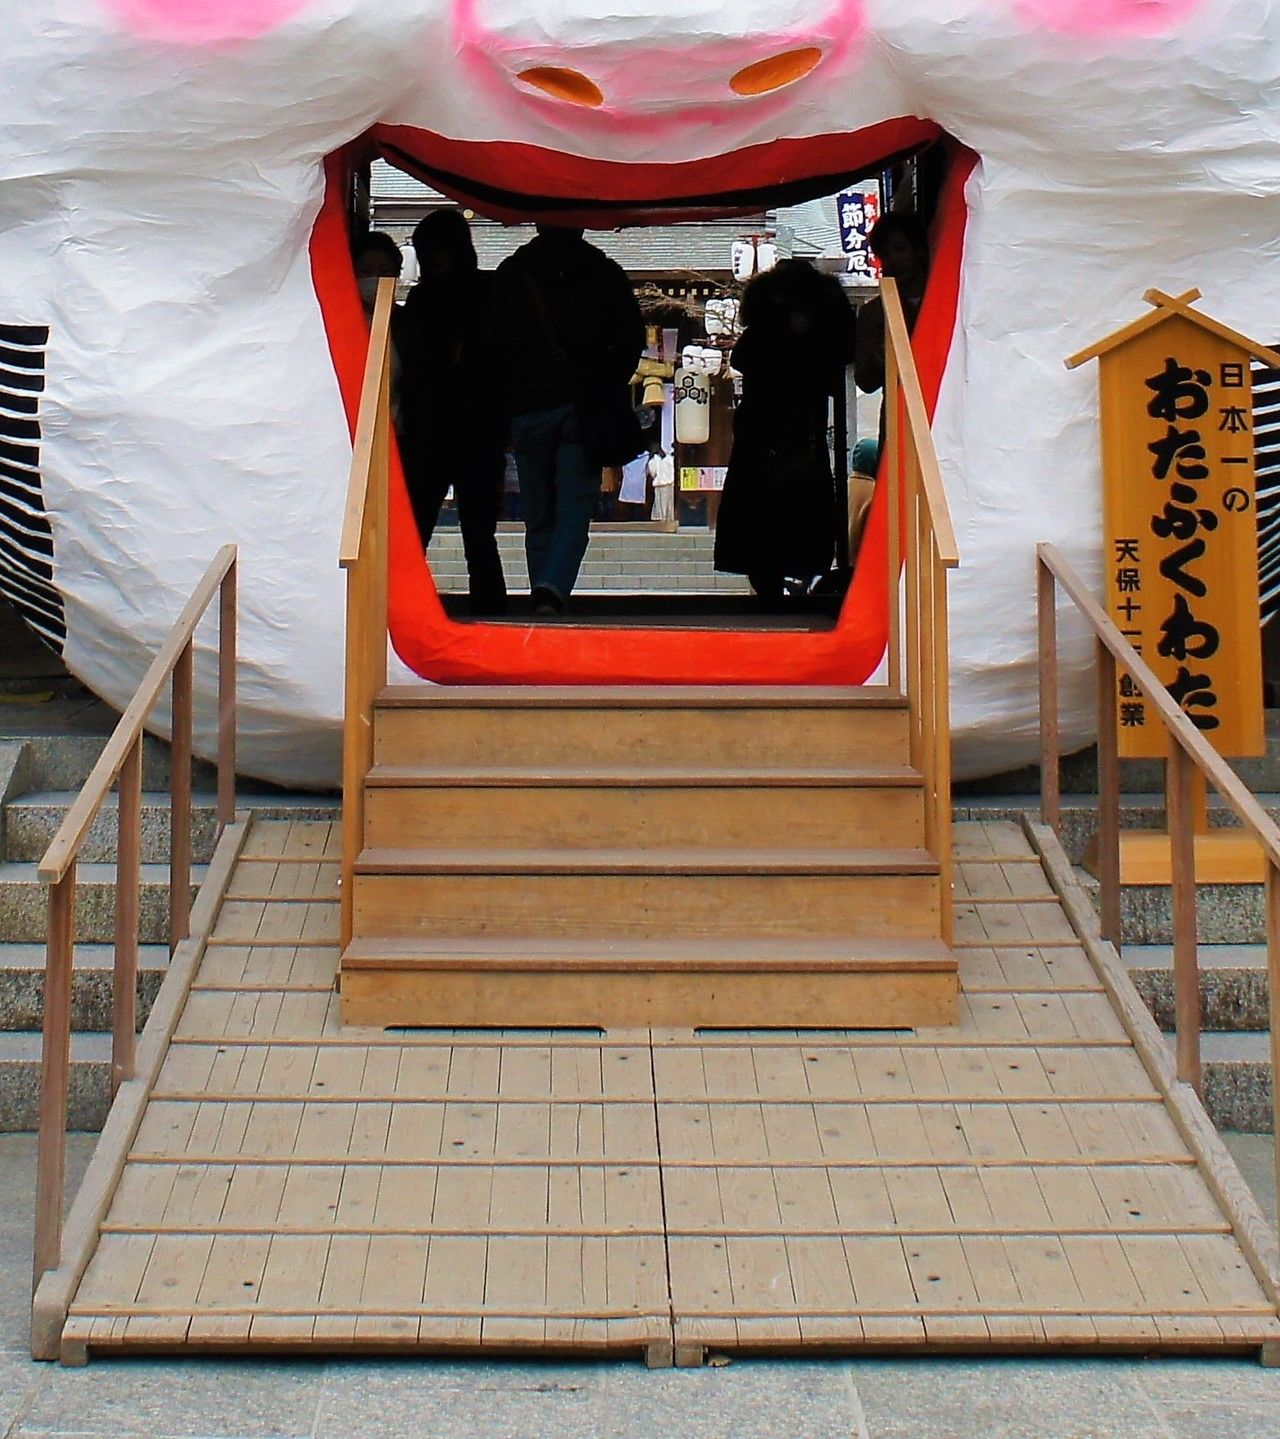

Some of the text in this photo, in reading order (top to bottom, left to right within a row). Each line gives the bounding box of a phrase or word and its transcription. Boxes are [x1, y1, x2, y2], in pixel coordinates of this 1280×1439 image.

[1218, 362, 1250, 513] 日本一の
[1114, 537, 1145, 727] 天保十一創業
[1145, 356, 1220, 731] おたふくわた
